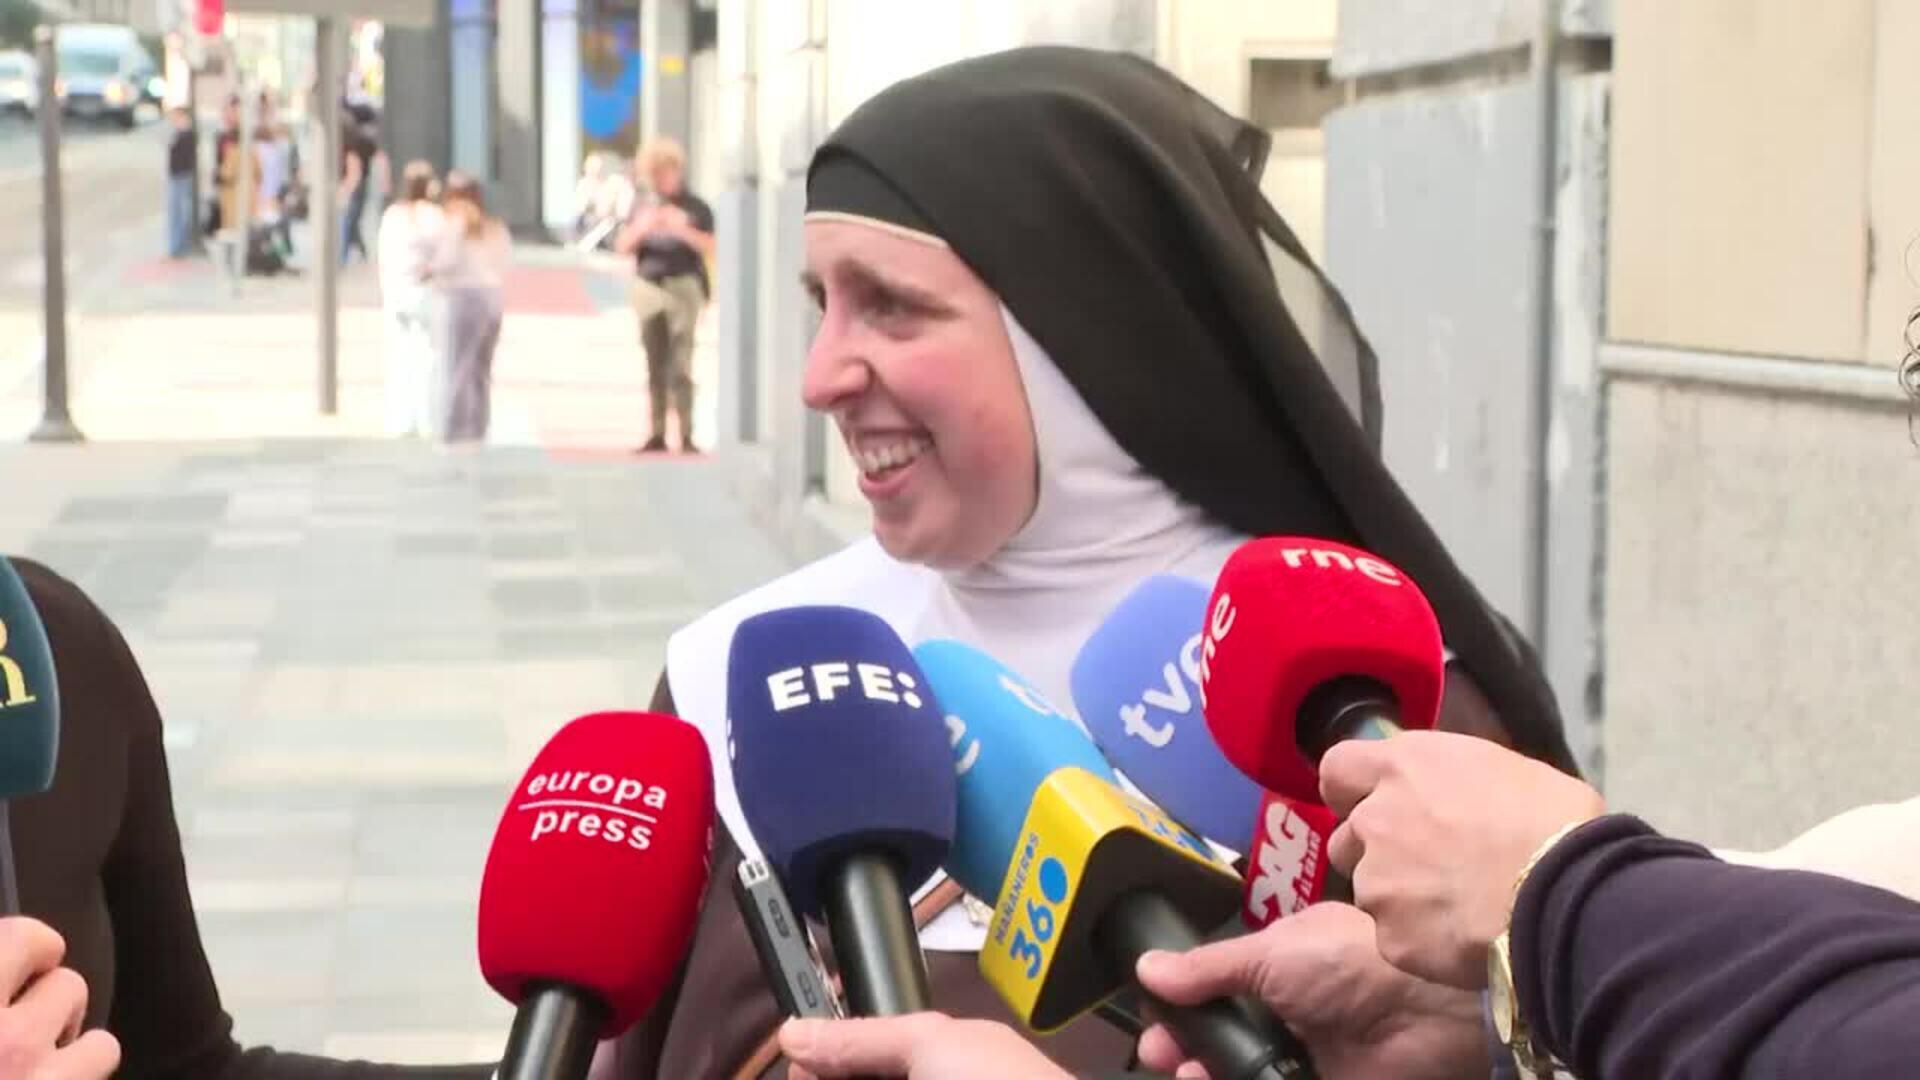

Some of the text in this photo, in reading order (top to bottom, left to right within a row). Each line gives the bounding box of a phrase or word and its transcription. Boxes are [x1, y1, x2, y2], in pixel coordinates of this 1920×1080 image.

[1281, 548, 1402, 586] rne
[766, 662, 922, 712] EFE:
[527, 770, 667, 810] europa
[530, 809, 652, 850] press
[1009, 856, 1068, 979] 360
